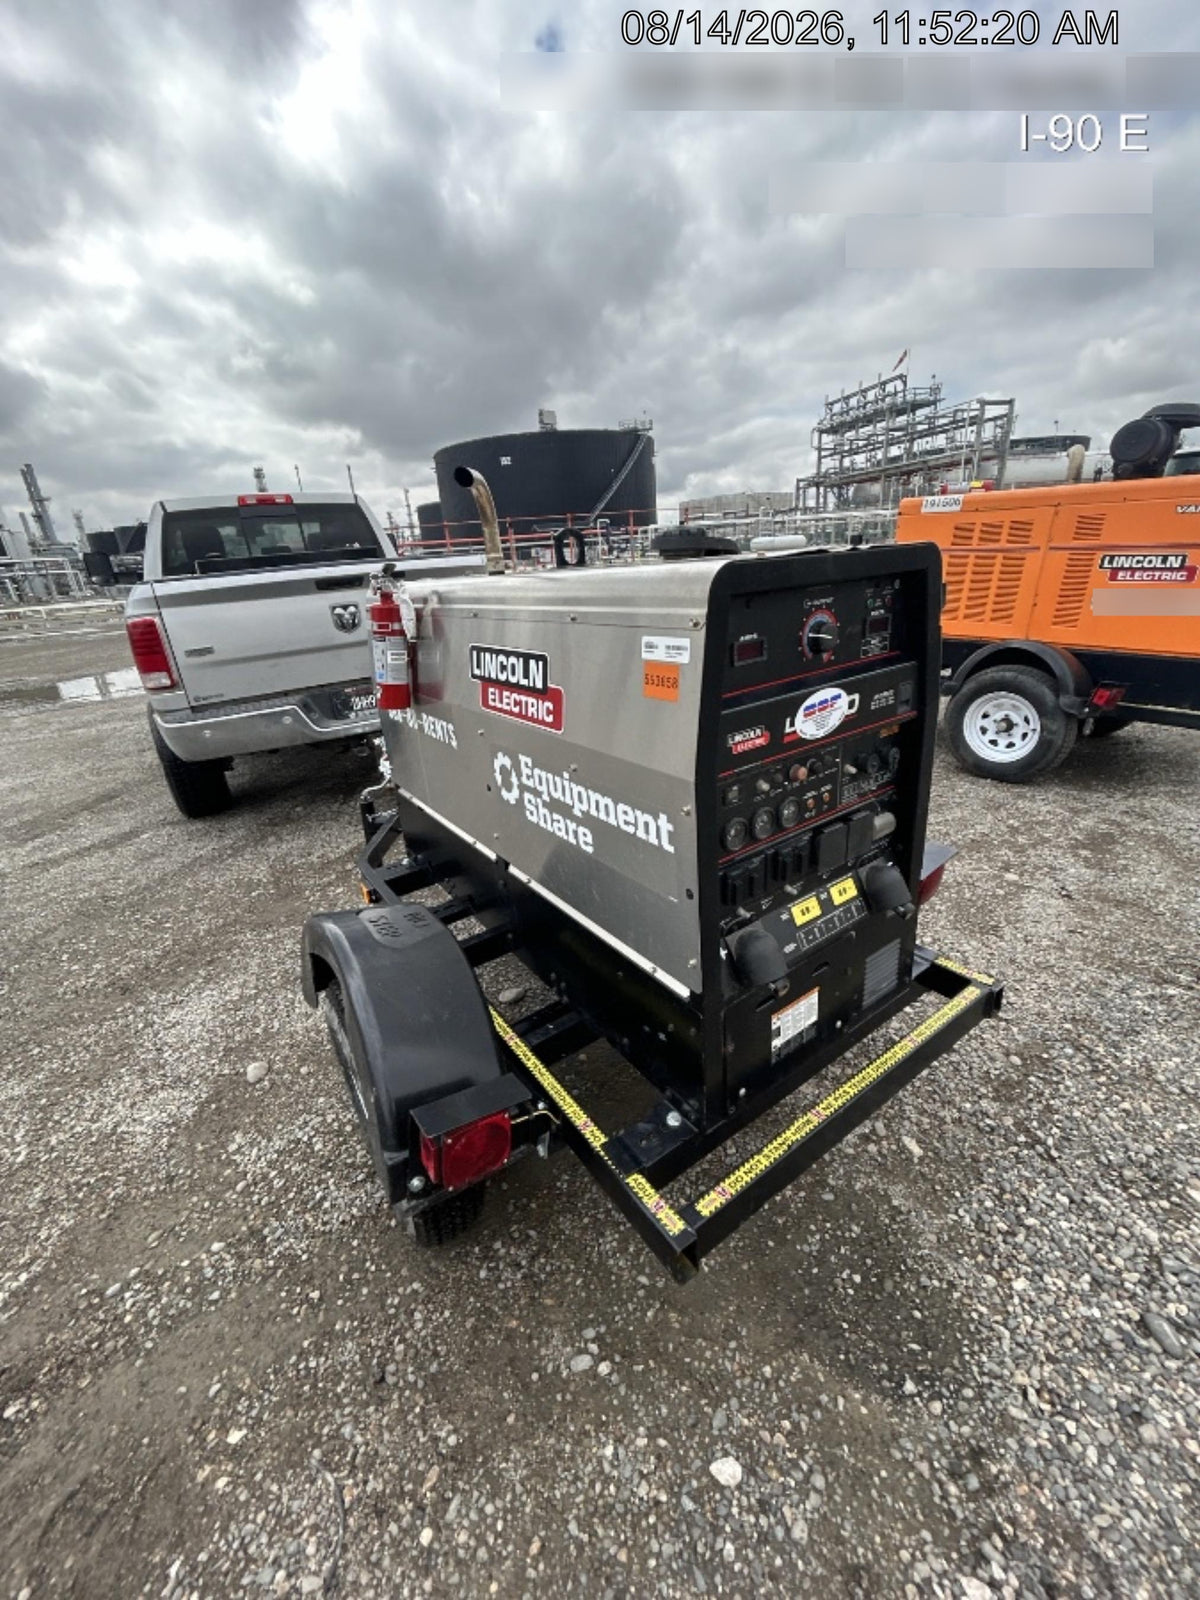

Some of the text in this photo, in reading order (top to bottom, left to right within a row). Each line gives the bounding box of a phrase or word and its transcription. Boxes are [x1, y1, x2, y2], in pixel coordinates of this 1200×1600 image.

[1102, 555, 1183, 568] LINCOLN
[1116, 571, 1188, 581] ELECTRIC
[472, 649, 543, 690] LINCOLN
[488, 687, 553, 723] ELECTRIC
[518, 753, 675, 853] Equipment
[523, 792, 594, 854] Share
[728, 1174, 745, 1190] DO
[742, 1159, 764, 1178] NOT
